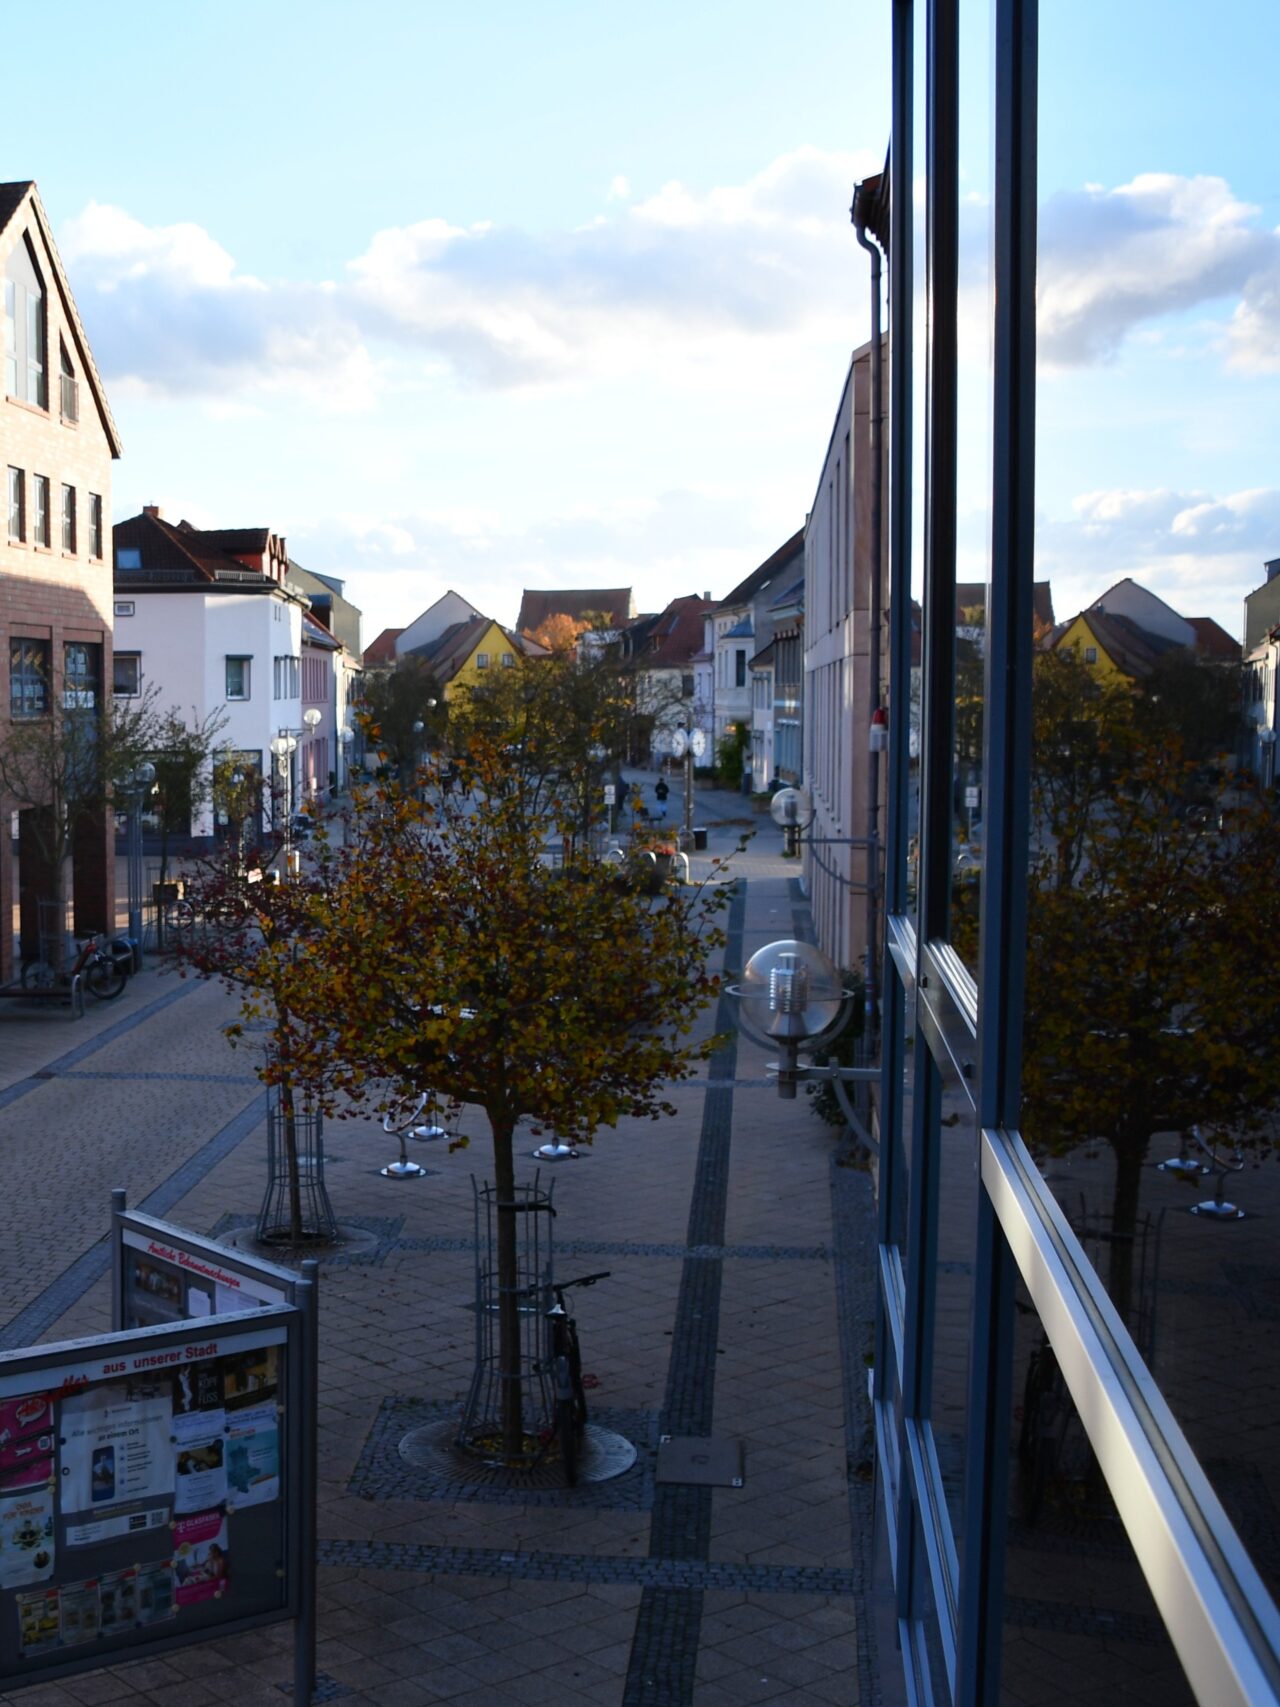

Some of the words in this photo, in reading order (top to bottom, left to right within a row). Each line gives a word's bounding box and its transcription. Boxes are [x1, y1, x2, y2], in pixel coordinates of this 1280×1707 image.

[148, 1242, 175, 1261] Amtliche
[103, 1361, 126, 1374] aus
[133, 1351, 182, 1369] unserer
[185, 1343, 218, 1359] Stadt
